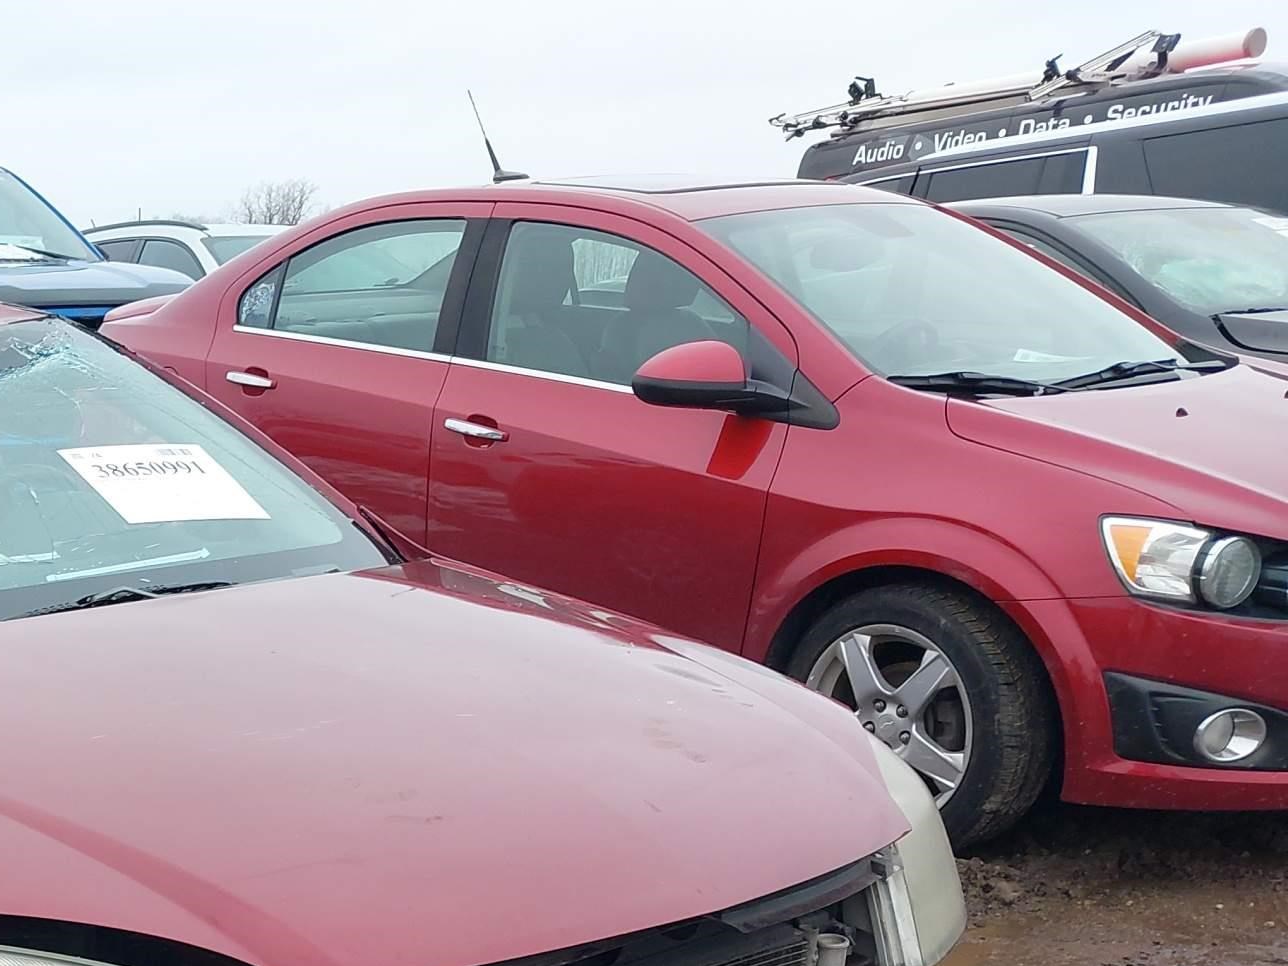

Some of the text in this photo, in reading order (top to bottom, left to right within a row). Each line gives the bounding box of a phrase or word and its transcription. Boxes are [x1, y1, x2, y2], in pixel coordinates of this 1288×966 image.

[852, 93, 1214, 165] Audio Video Data Security
[91, 460, 206, 478] 38650991
